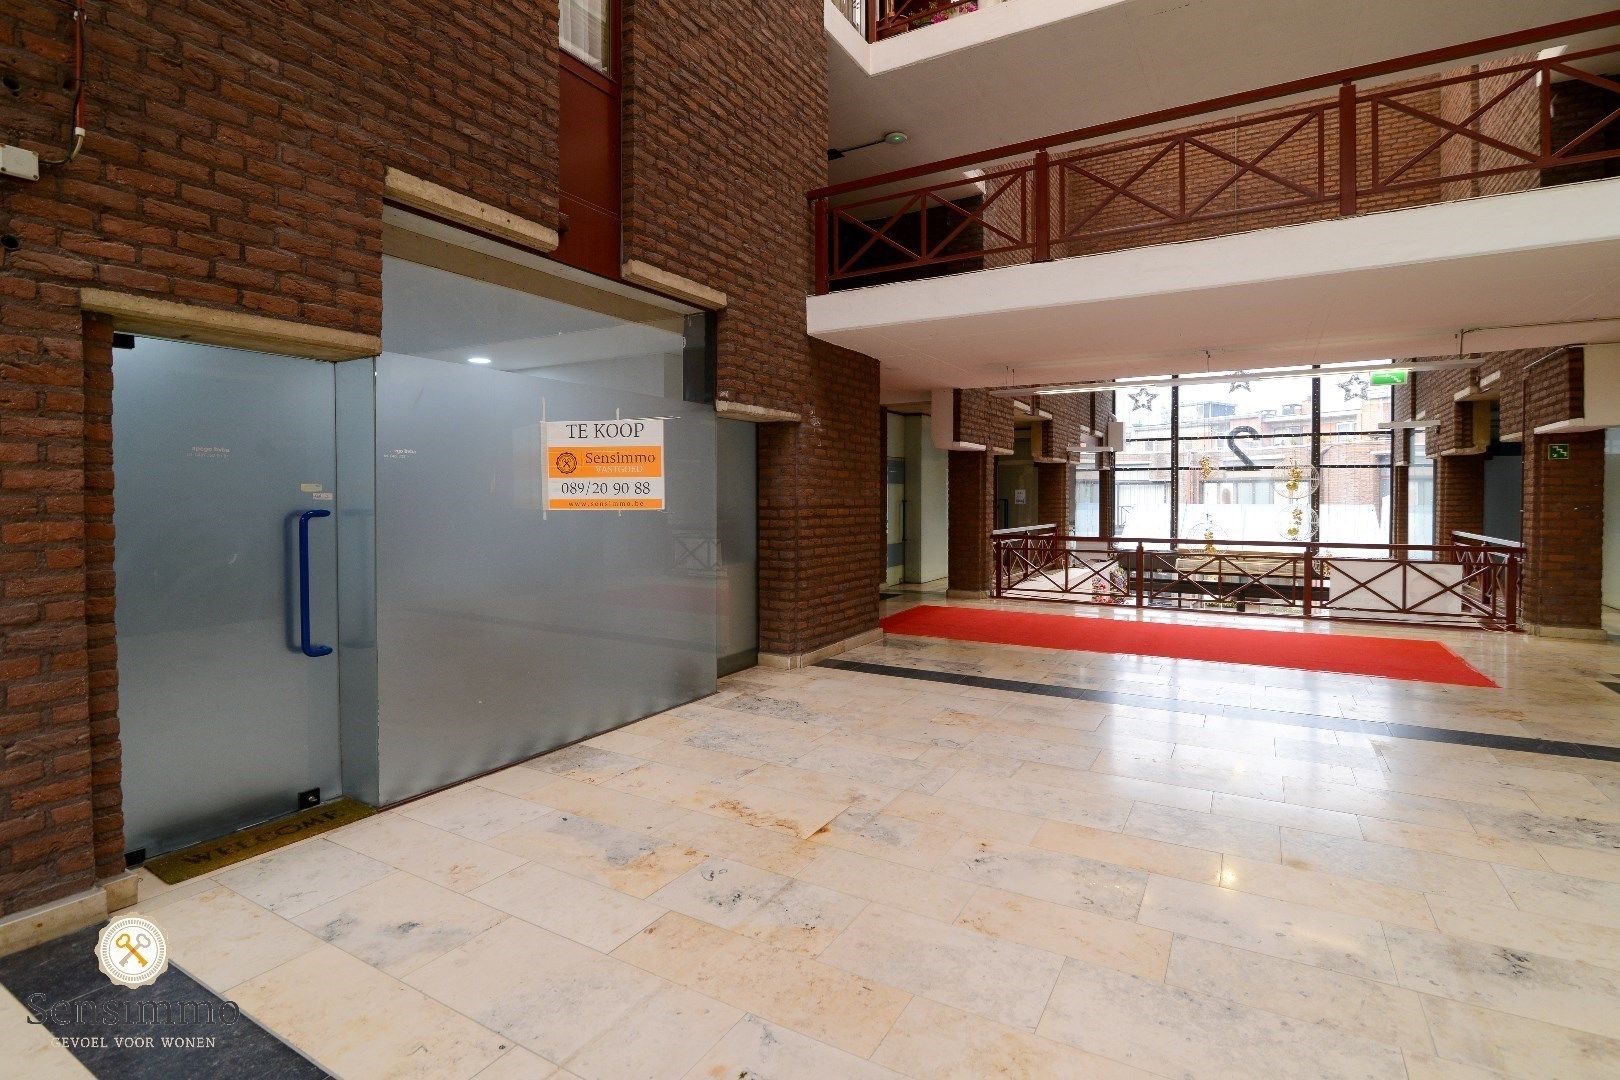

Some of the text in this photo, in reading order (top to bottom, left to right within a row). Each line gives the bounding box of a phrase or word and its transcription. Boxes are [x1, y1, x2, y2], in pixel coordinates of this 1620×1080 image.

[566, 422, 645, 439] TE KOOP
[585, 451, 656, 464] Sensimmo
[594, 465, 645, 473] VASTGOED
[561, 481, 651, 496] 089/20 90 88
[568, 500, 645, 508] www.sensimmo.be
